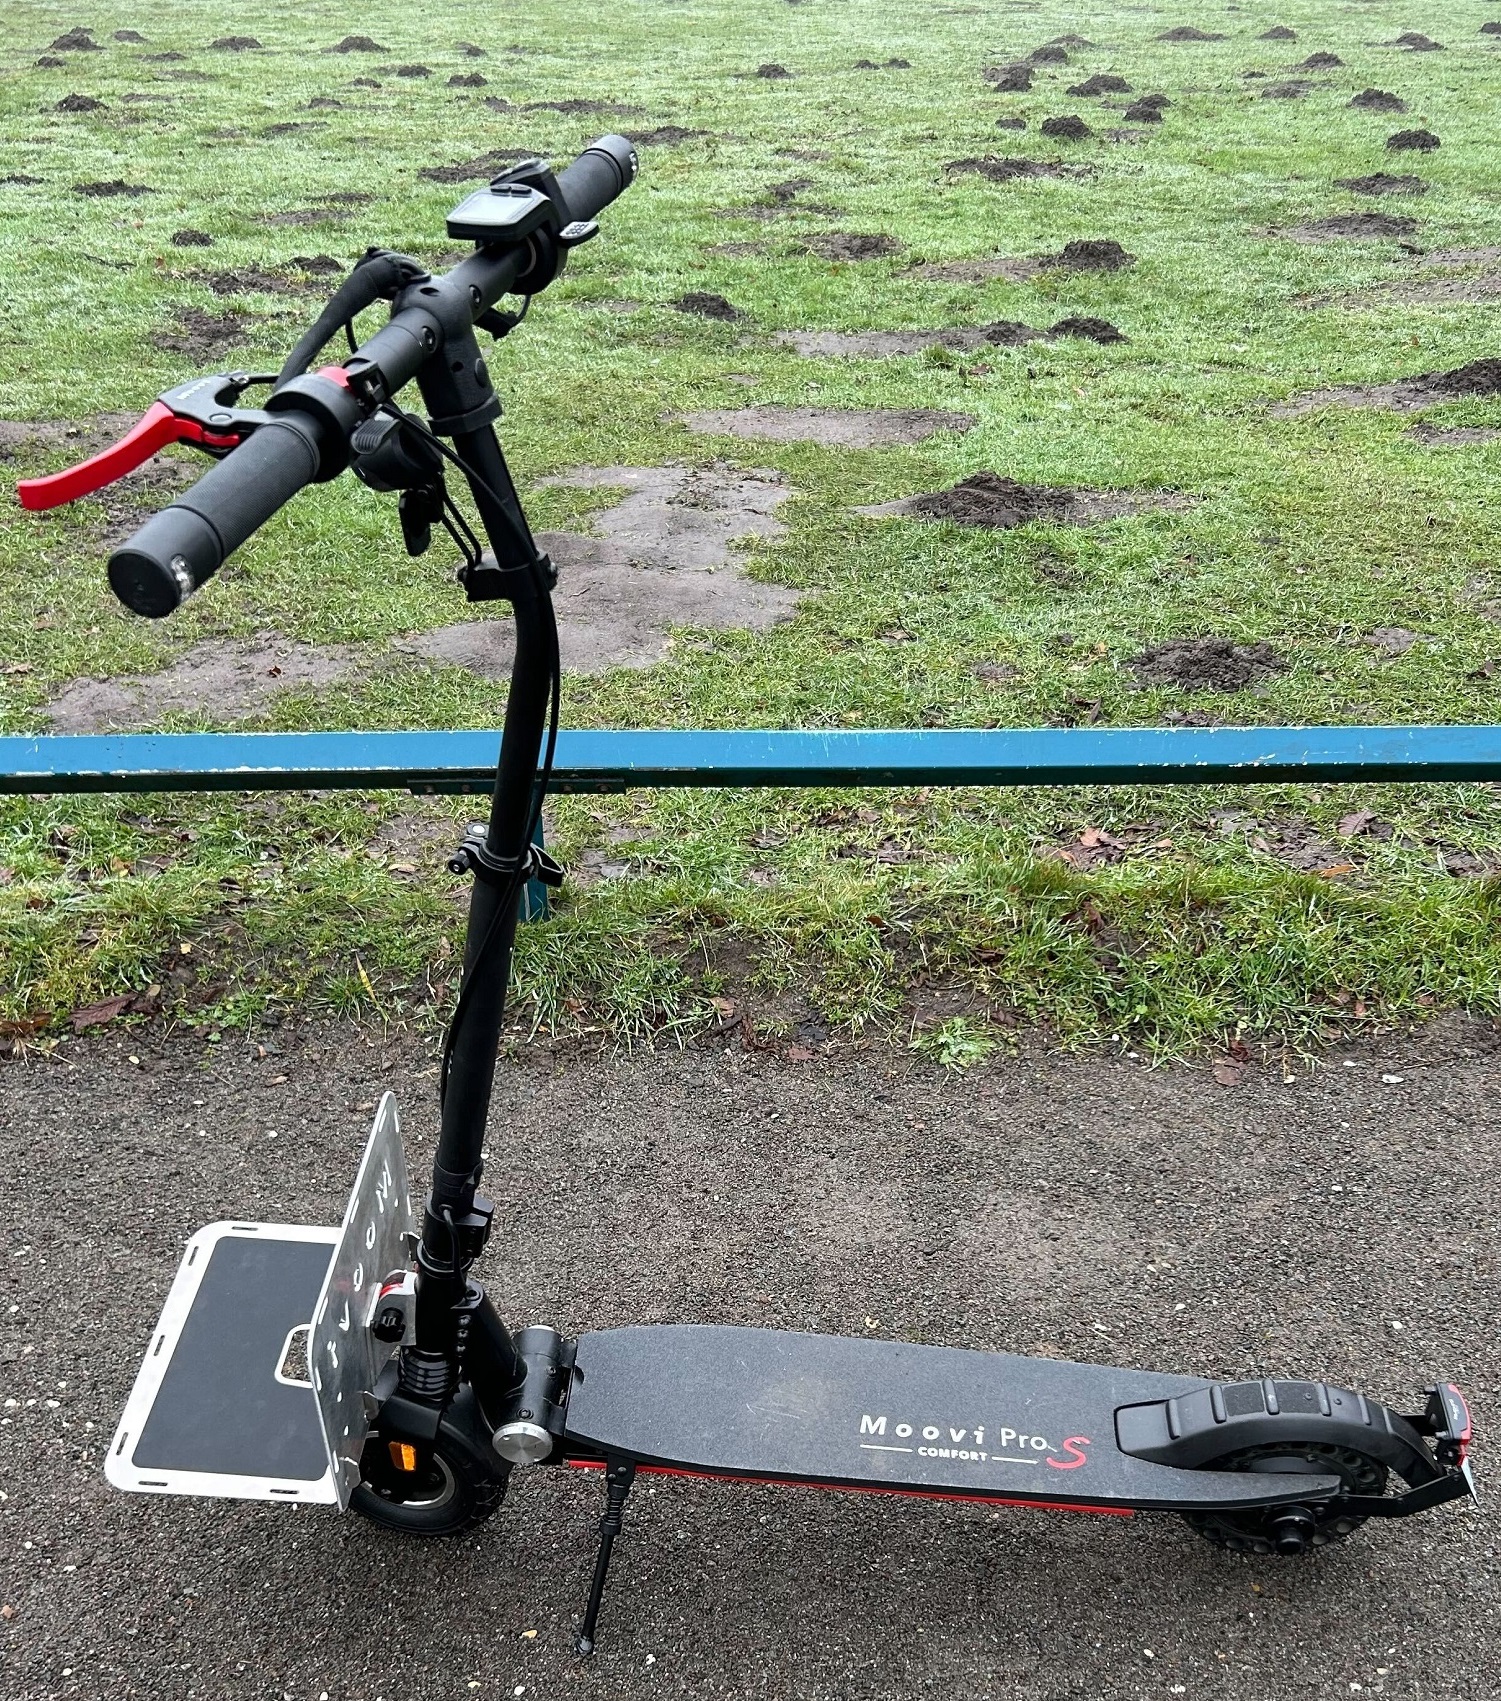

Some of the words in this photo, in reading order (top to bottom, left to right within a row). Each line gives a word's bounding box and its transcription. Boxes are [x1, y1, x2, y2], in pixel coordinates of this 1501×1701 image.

[859, 1414, 985, 1445] Moovi
[1000, 1427, 1048, 1451] Pro
[1046, 1436, 1091, 1470] S
[917, 1446, 988, 1462] COMFORT
